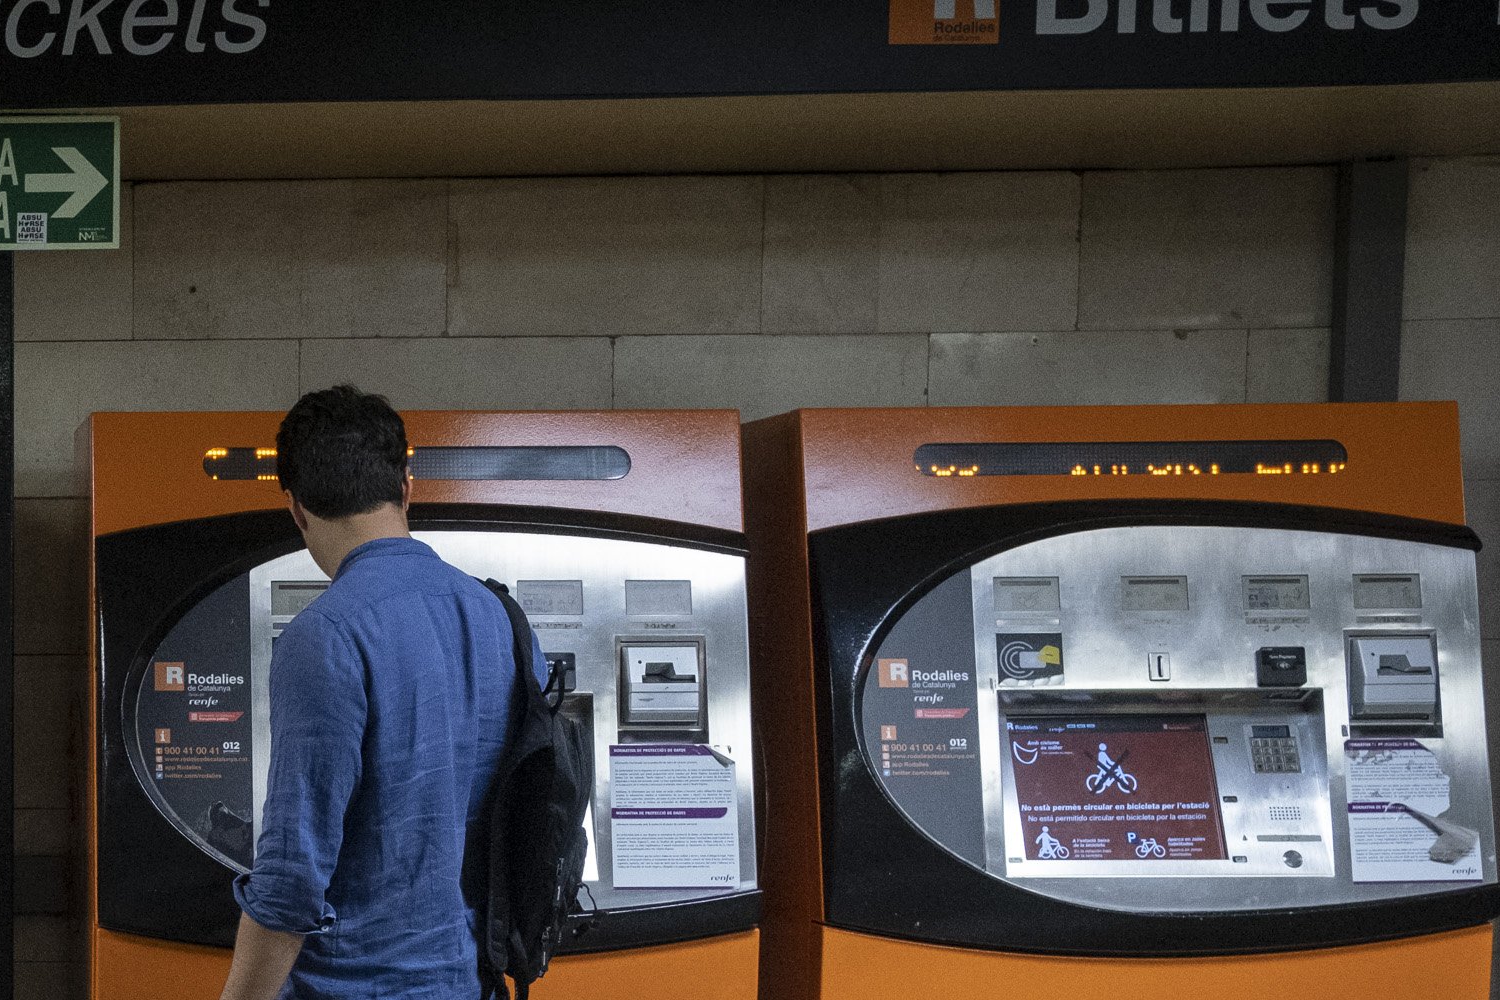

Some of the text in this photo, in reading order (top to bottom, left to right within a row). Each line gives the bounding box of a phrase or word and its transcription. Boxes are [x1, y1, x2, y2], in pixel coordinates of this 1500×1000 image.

[933, 21, 995, 34] Rodalies
[188, 674, 244, 684] Rodalies
[912, 670, 969, 681] Rodalies
[198, 685, 231, 693] Catalunya
[922, 681, 956, 689] Catalunya
[188, 696, 218, 708] renfe
[914, 693, 943, 704] renfe
[222, 742, 240, 750] 012
[1053, 804, 1081, 812] permès
[1055, 815, 1087, 823] permitido
[1127, 832, 1136, 843] P
